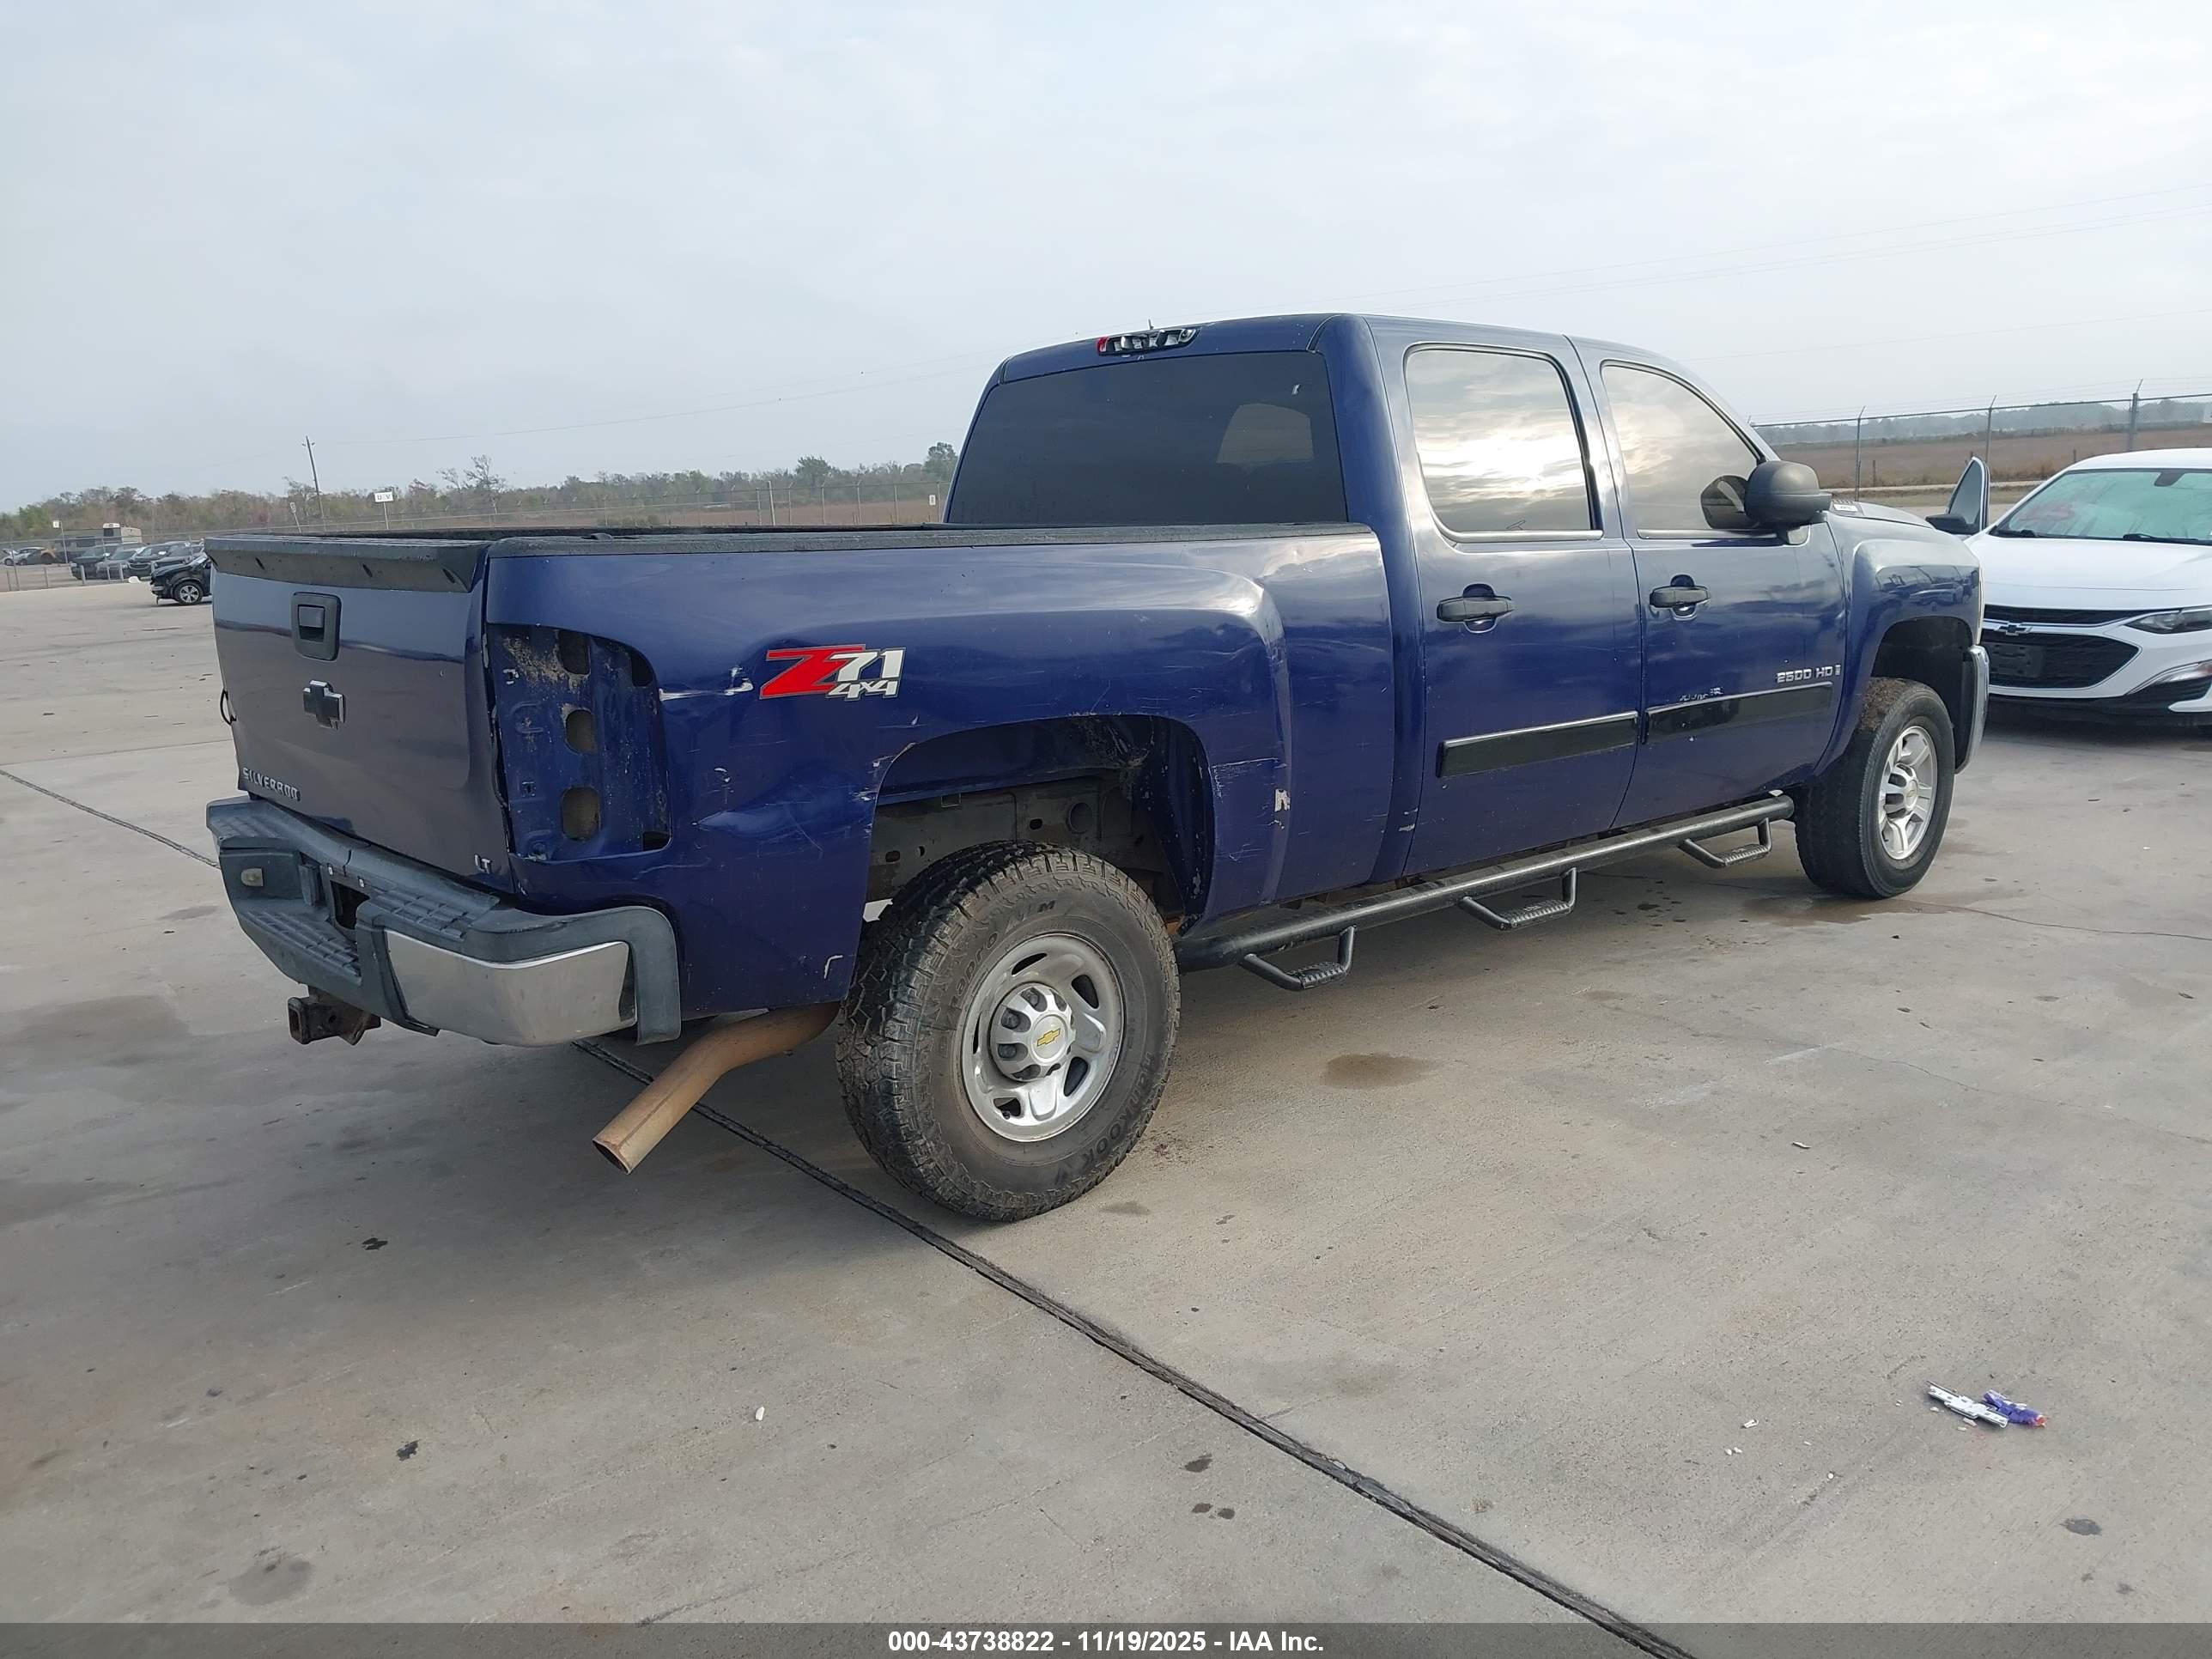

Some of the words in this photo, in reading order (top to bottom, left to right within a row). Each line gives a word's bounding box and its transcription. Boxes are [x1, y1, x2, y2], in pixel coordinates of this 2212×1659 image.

[759, 644, 906, 700] Z71
[1776, 668, 1813, 684] 2500
[1814, 665, 1833, 678] HD
[241, 767, 301, 801] SILVERADO
[474, 854, 491, 875] LT
